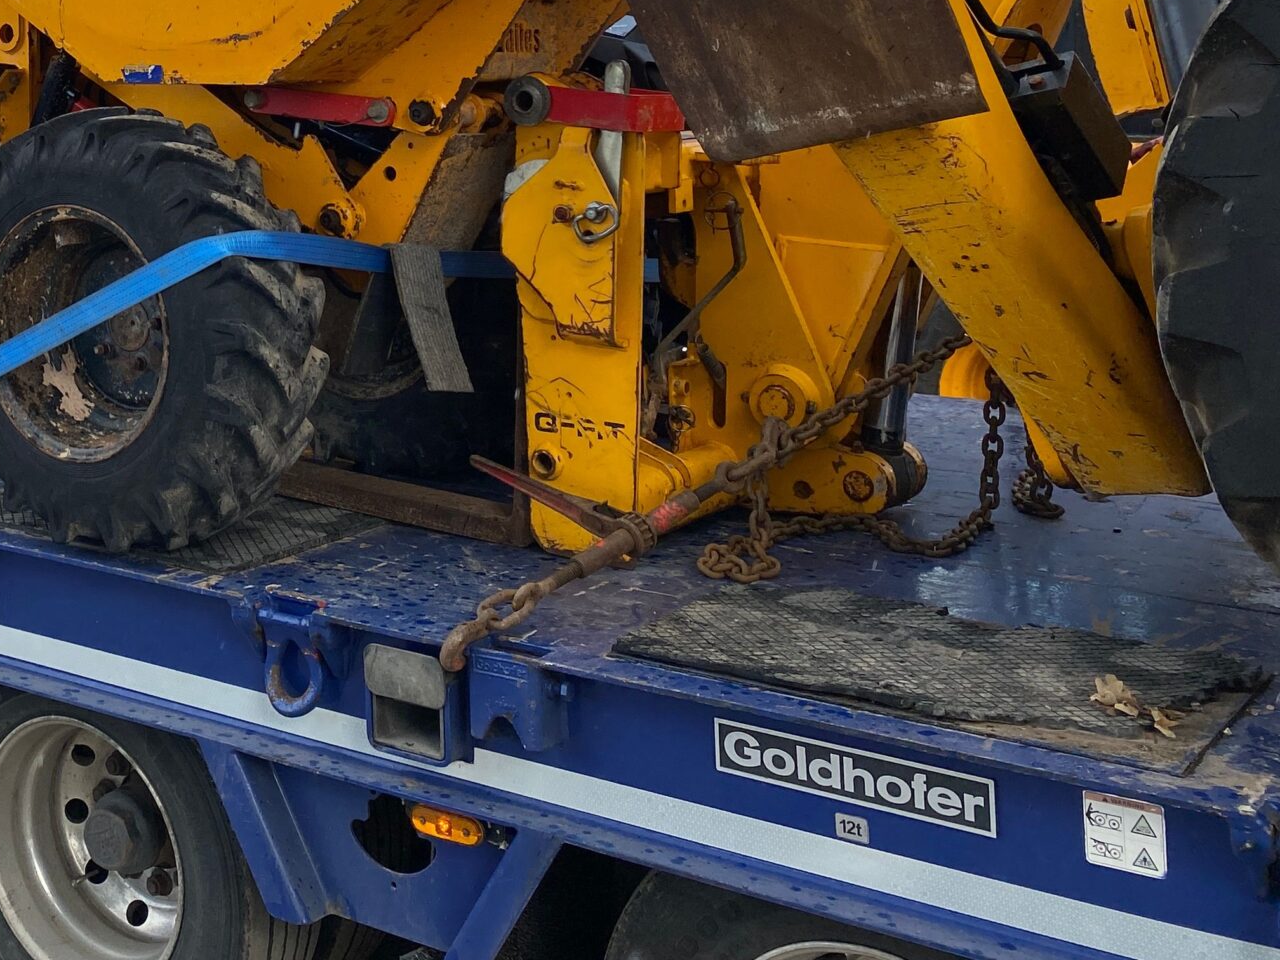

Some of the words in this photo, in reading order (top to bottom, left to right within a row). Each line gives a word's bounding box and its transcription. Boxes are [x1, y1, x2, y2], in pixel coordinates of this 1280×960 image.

[496, 23, 540, 53] aites
[723, 731, 984, 822] Goldhofer
[839, 818, 863, 838] 12t
